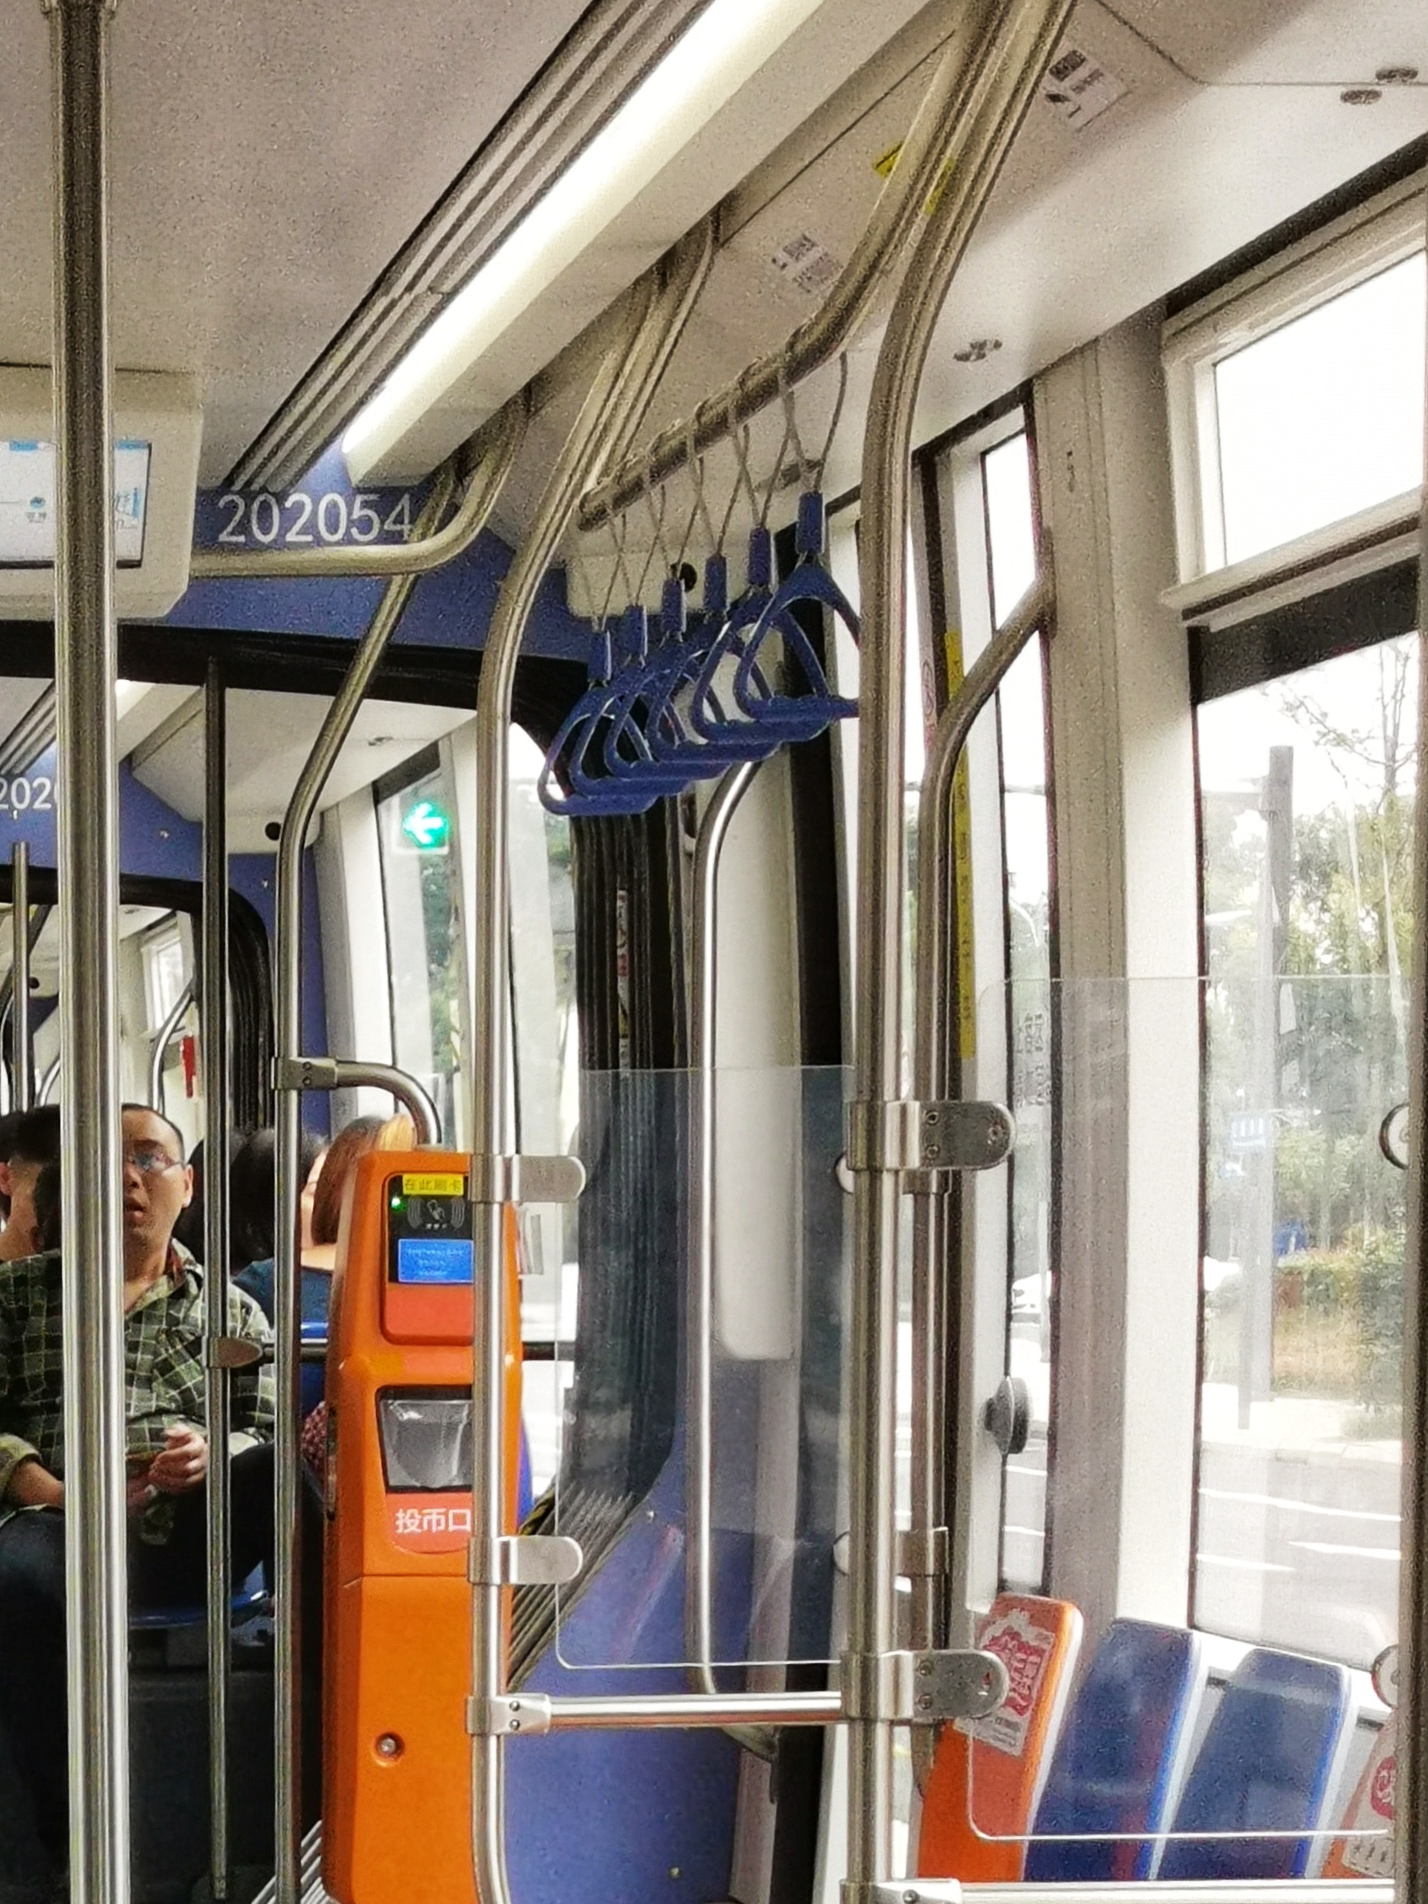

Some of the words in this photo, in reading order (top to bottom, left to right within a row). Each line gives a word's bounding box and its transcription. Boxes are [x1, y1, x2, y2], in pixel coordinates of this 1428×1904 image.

[217, 492, 414, 543] 202054
[395, 1507, 472, 1534] 投币口
